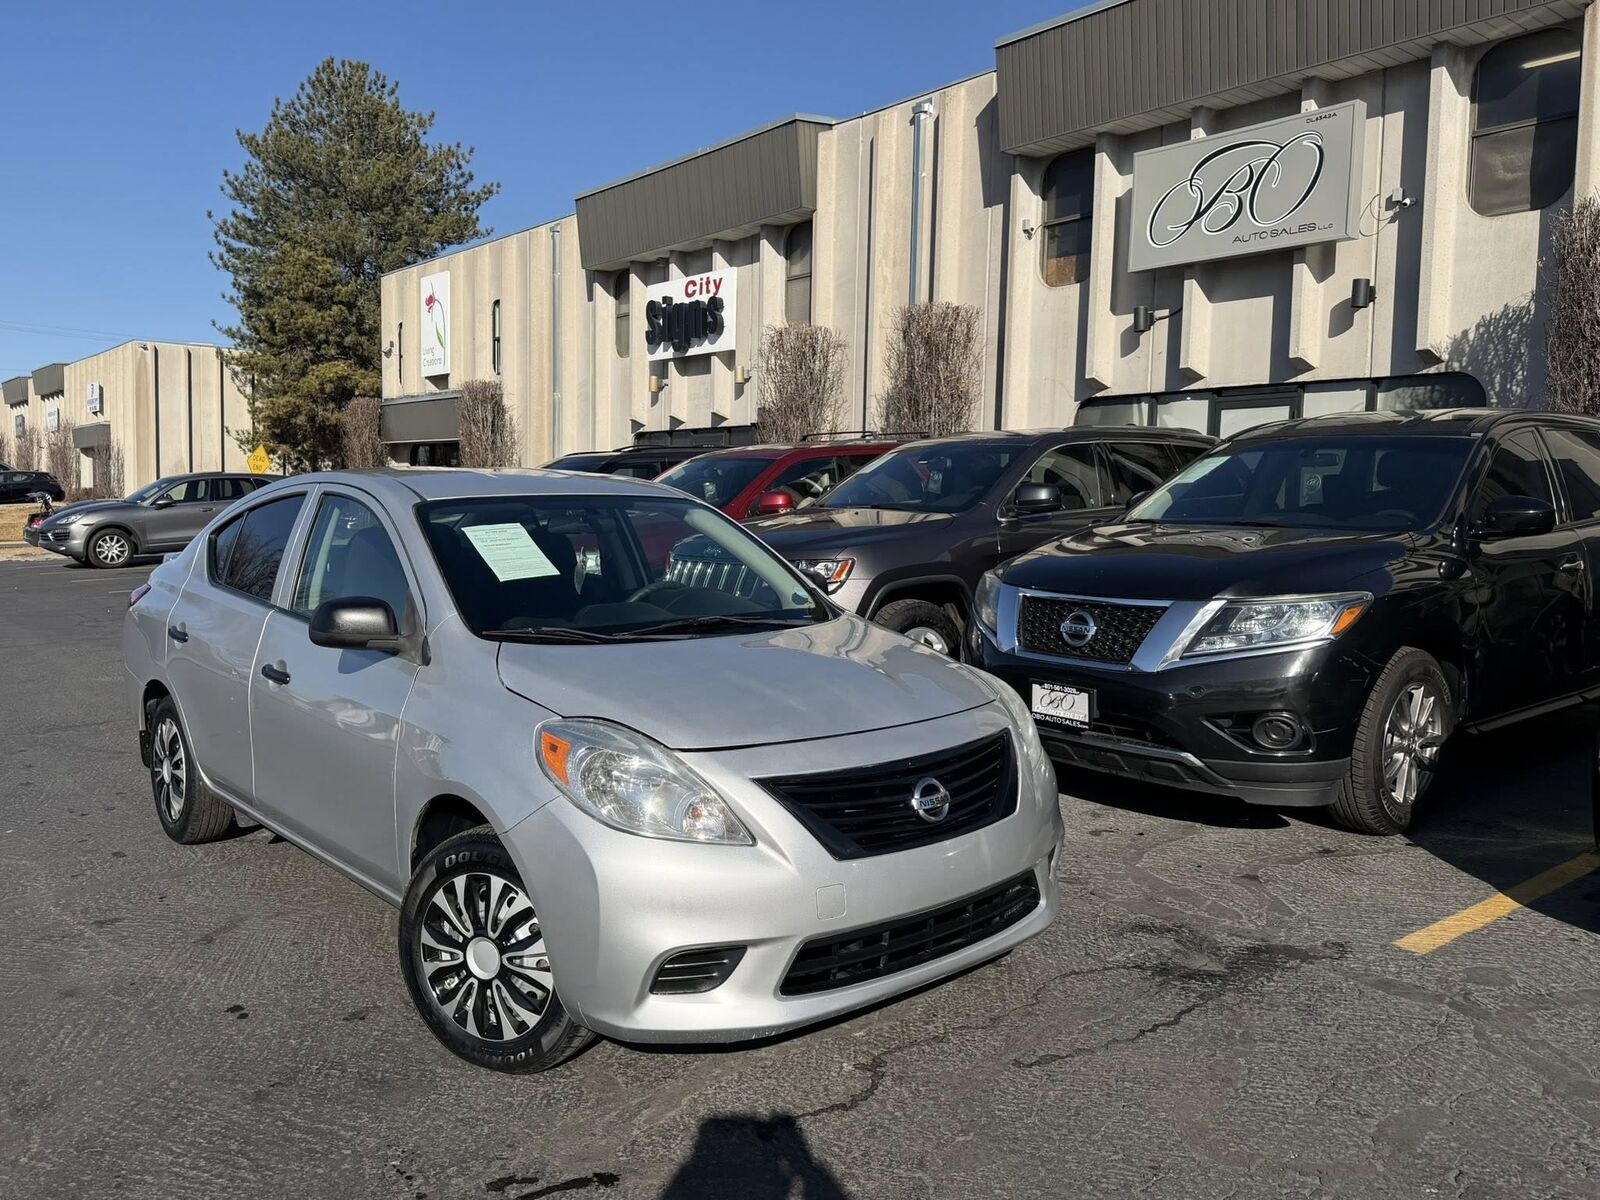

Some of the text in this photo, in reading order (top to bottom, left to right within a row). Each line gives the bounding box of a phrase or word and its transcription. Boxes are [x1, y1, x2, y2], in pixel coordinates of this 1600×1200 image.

[1231, 222, 1334, 245] AUTO SALES LLC
[684, 277, 723, 298] City
[645, 295, 724, 354] Signs
[252, 454, 266, 463] DEAD
[252, 463, 263, 471] END
[1062, 624, 1090, 634] NISSAN
[1045, 715, 1062, 724] AUTO
